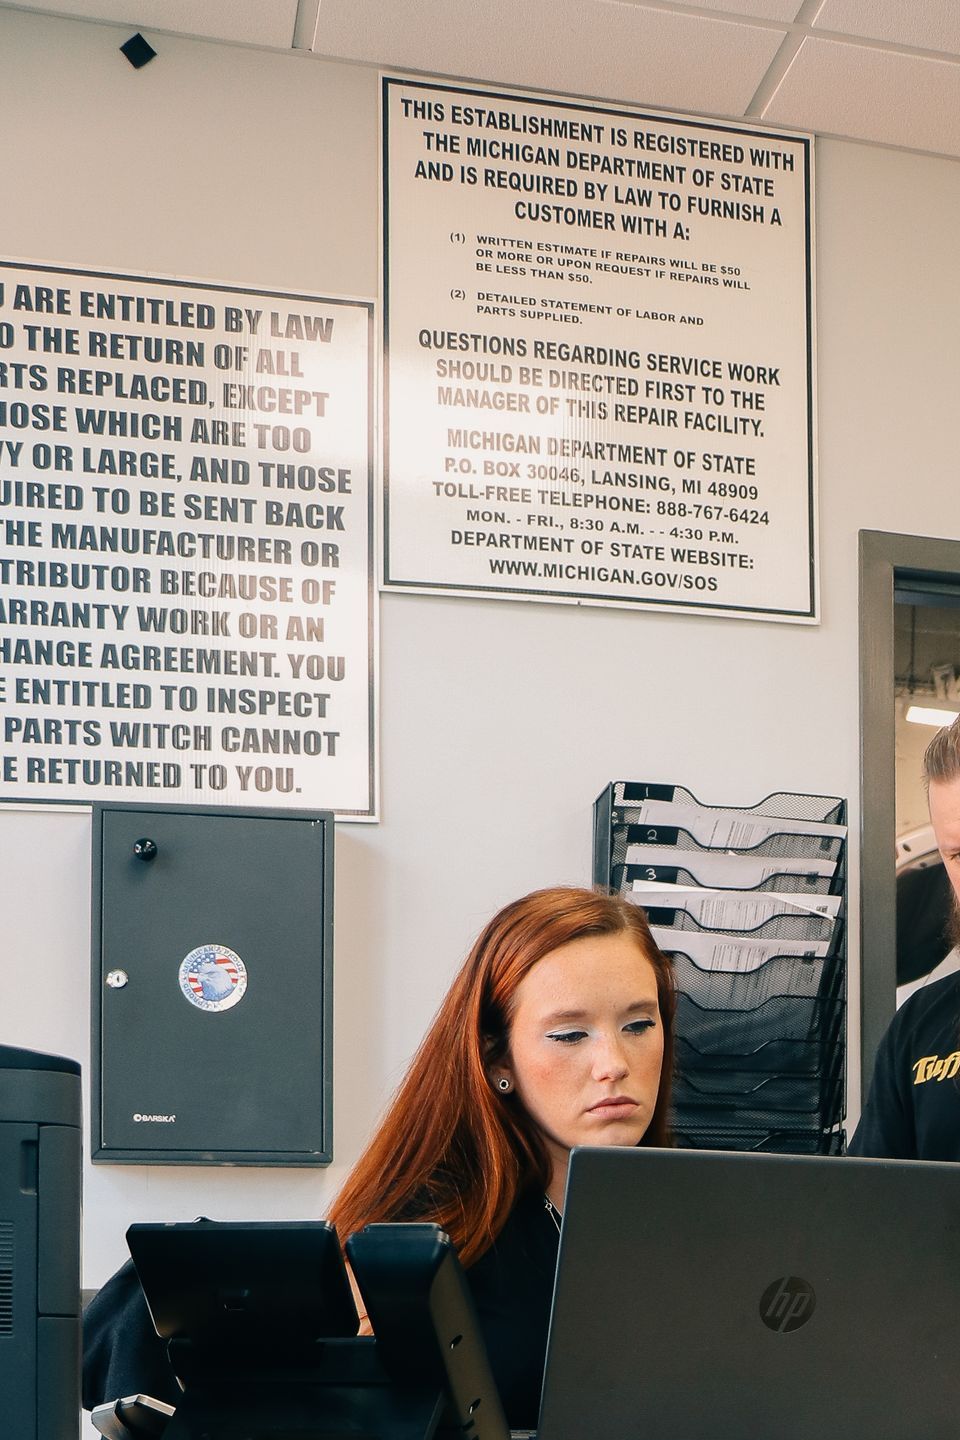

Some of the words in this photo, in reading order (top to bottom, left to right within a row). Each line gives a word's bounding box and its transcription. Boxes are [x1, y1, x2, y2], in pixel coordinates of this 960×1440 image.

[401, 98, 444, 121] THIS
[452, 105, 604, 143] ESTABLISHMENT
[611, 128, 627, 146] IS
[634, 131, 744, 163] REGISTERED
[750, 148, 793, 171] WITH
[423, 132, 460, 154] THE
[467, 137, 559, 167] MICHIGAN
[567, 151, 686, 184] DEPARTMENT
[693, 169, 714, 187] OF
[721, 173, 774, 197] STATE
[415, 160, 453, 181] AND
[461, 166, 477, 185] IS
[485, 169, 577, 197] REQUIRED
[585, 182, 608, 201] BY
[615, 186, 652, 207] LAW
[658, 192, 681, 211] TO
[688, 196, 764, 223] FURNISH
[771, 208, 781, 225] A
[515, 202, 615, 231] CUSTOMER
[621, 215, 666, 237] WITH
[673, 222, 689, 240] A:
[451, 233, 465, 243] (1)
[477, 236, 532, 250] WRITTEN
[537, 243, 597, 258] ESTIMATE
[616, 253, 665, 265] REPAIRS
[670, 259, 697, 270] WILL
[702, 264, 716, 272] BE
[721, 266, 740, 276] $50
[476, 249, 493, 258] OR
[498, 251, 532, 262] MORE
[537, 256, 553, 265] OR
[558, 258, 591, 269] UPON
[596, 263, 651, 276] REQUEST
[656, 270, 665, 278] IF
[670, 272, 719, 285] REPAIRS
[723, 279, 750, 290] WILL
[476, 263, 491, 272] BE
[497, 265, 526, 275] LESS
[530, 269, 563, 280] THAN
[569, 273, 592, 283] $50.
[13, 285, 71, 315] ARE
[80, 291, 215, 330] ENTITLED
[225, 307, 262, 334] BY
[271, 312, 334, 342] LAW
[451, 290, 465, 300] (2)
[478, 292, 536, 305] DETAILED
[541, 299, 612, 314] STATEMENT
[617, 308, 631, 316] OF
[636, 310, 675, 322] LABOR
[680, 316, 703, 325] AND
[477, 305, 515, 316] PARTS
[520, 310, 582, 324] SUPPLIED.
[23, 325, 79, 355] THE
[89, 331, 204, 367] RETURN
[214, 344, 249, 371] OF
[256, 349, 304, 377] ALL
[419, 330, 526, 356] QUESTIONS
[534, 341, 640, 369] REGARDING
[647, 354, 722, 378] SERVICE
[728, 363, 780, 385] WORK
[58, 367, 214, 409] REPLACED,
[223, 383, 329, 417] EXCEPT
[437, 359, 512, 383] SHOULD
[520, 367, 542, 386] BE
[549, 370, 638, 396] DIRECTED
[646, 380, 695, 402] FIRST
[702, 387, 724, 406] TO
[731, 390, 764, 411] THE
[75, 408, 182, 441] WHICH
[191, 418, 246, 447] ARE
[254, 424, 311, 453] TOO
[438, 386, 530, 413] MANAGER
[536, 396, 559, 415] OF
[566, 399, 608, 420] THIS
[615, 404, 678, 427] REPAIR
[685, 412, 763, 437] FACILITY.
[0, 441, 23, 467] Y
[33, 444, 72, 471] OR
[83, 448, 182, 482] LARGE,
[190, 457, 249, 485] AND
[258, 462, 351, 494] THOSE
[448, 429, 540, 454] MICHIGAN
[548, 438, 667, 466] DEPARTMENT
[674, 451, 695, 468] OF
[702, 454, 755, 475] STATE
[445, 457, 476, 474] P.O.
[484, 461, 520, 477] BOX
[528, 464, 584, 486] 30046,
[592, 470, 675, 495] LANSING,
[683, 479, 700, 494] MI
[708, 482, 758, 500] 48909
[92, 487, 130, 514] TO
[140, 491, 175, 517] BE
[184, 494, 257, 523] SENT
[266, 501, 345, 531] BACK
[433, 482, 531, 503] TOLL-FREE
[538, 490, 650, 513] TELEPHONE:
[657, 501, 769, 525] 888-767-6424
[0, 520, 42, 547] HE
[52, 523, 291, 564] MANUFACTURER
[301, 541, 339, 568] OR
[467, 510, 510, 523] MON.
[528, 515, 563, 530] FRI.,
[570, 518, 603, 531] 8:30
[610, 522, 644, 534] A.M.
[670, 528, 702, 540] 4:30
[709, 531, 738, 543] P.M.
[452, 530, 574, 553] DEPARTMENT
[581, 541, 603, 555] OF
[611, 543, 664, 561] STATE
[671, 548, 753, 569] WEBSITE:
[161, 569, 293, 602] BECAUSE
[302, 579, 336, 605] OF
[490, 559, 717, 591] WWW.MICHIGAN.GOV/SOS
[137, 606, 231, 636] WORK
[239, 613, 277, 639] OR
[286, 616, 324, 642] AN
[100, 644, 280, 678] AGREEMENT.
[288, 654, 345, 681] YOU
[16, 678, 151, 709] ENTITLED
[160, 685, 197, 712] TO
[207, 688, 330, 718] INSPECT
[5, 717, 101, 746] PARTS
[110, 722, 211, 751] WITCH
[222, 727, 340, 756] CANNOT
[1, 757, 18, 782] E
[27, 757, 181, 788] RETURNED
[190, 764, 227, 790] TO
[235, 766, 301, 793] YOU.
[646, 829, 658, 841] 2
[645, 868, 657, 880] 3
[141, 1114, 177, 1123] BARSKA
[760, 1276, 815, 1334] hp
